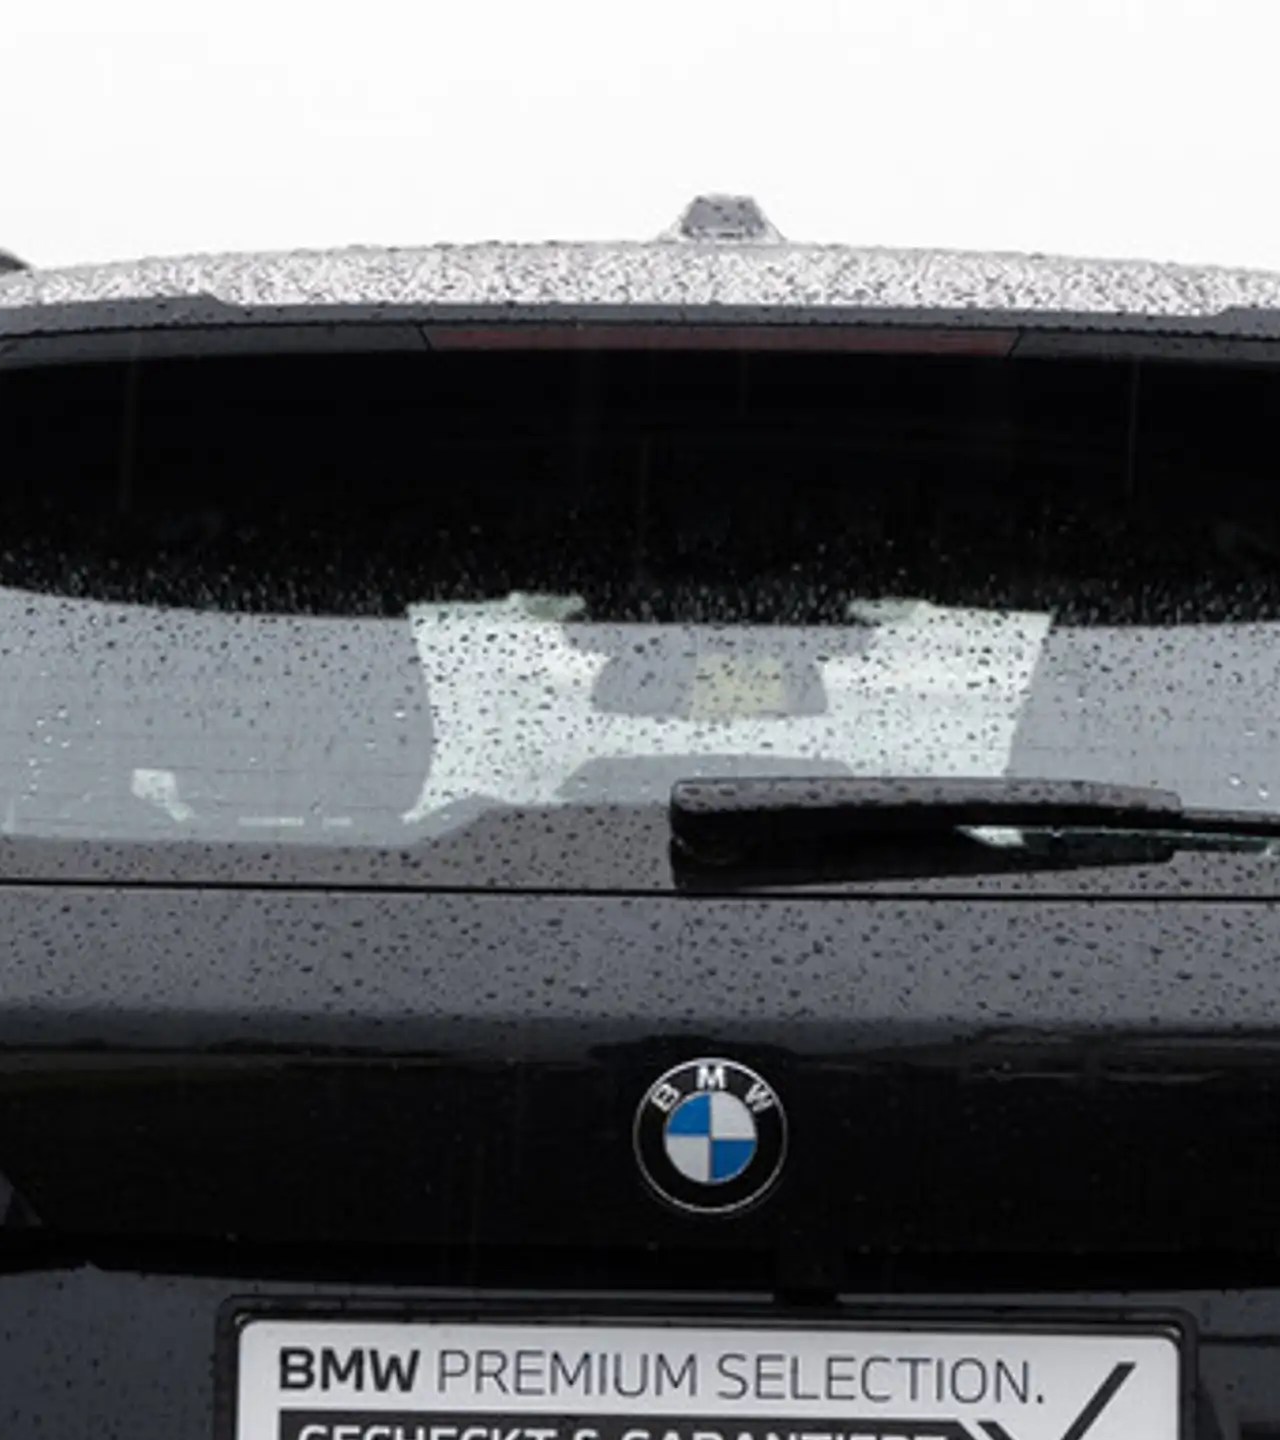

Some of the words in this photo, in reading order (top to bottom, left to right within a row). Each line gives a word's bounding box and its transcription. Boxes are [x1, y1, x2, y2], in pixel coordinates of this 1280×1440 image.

[649, 1063, 774, 1114] BMW
[277, 1345, 421, 1392] BMW
[436, 1348, 699, 1398] PREMIUM
[715, 1352, 1045, 1405] SELECTION.
